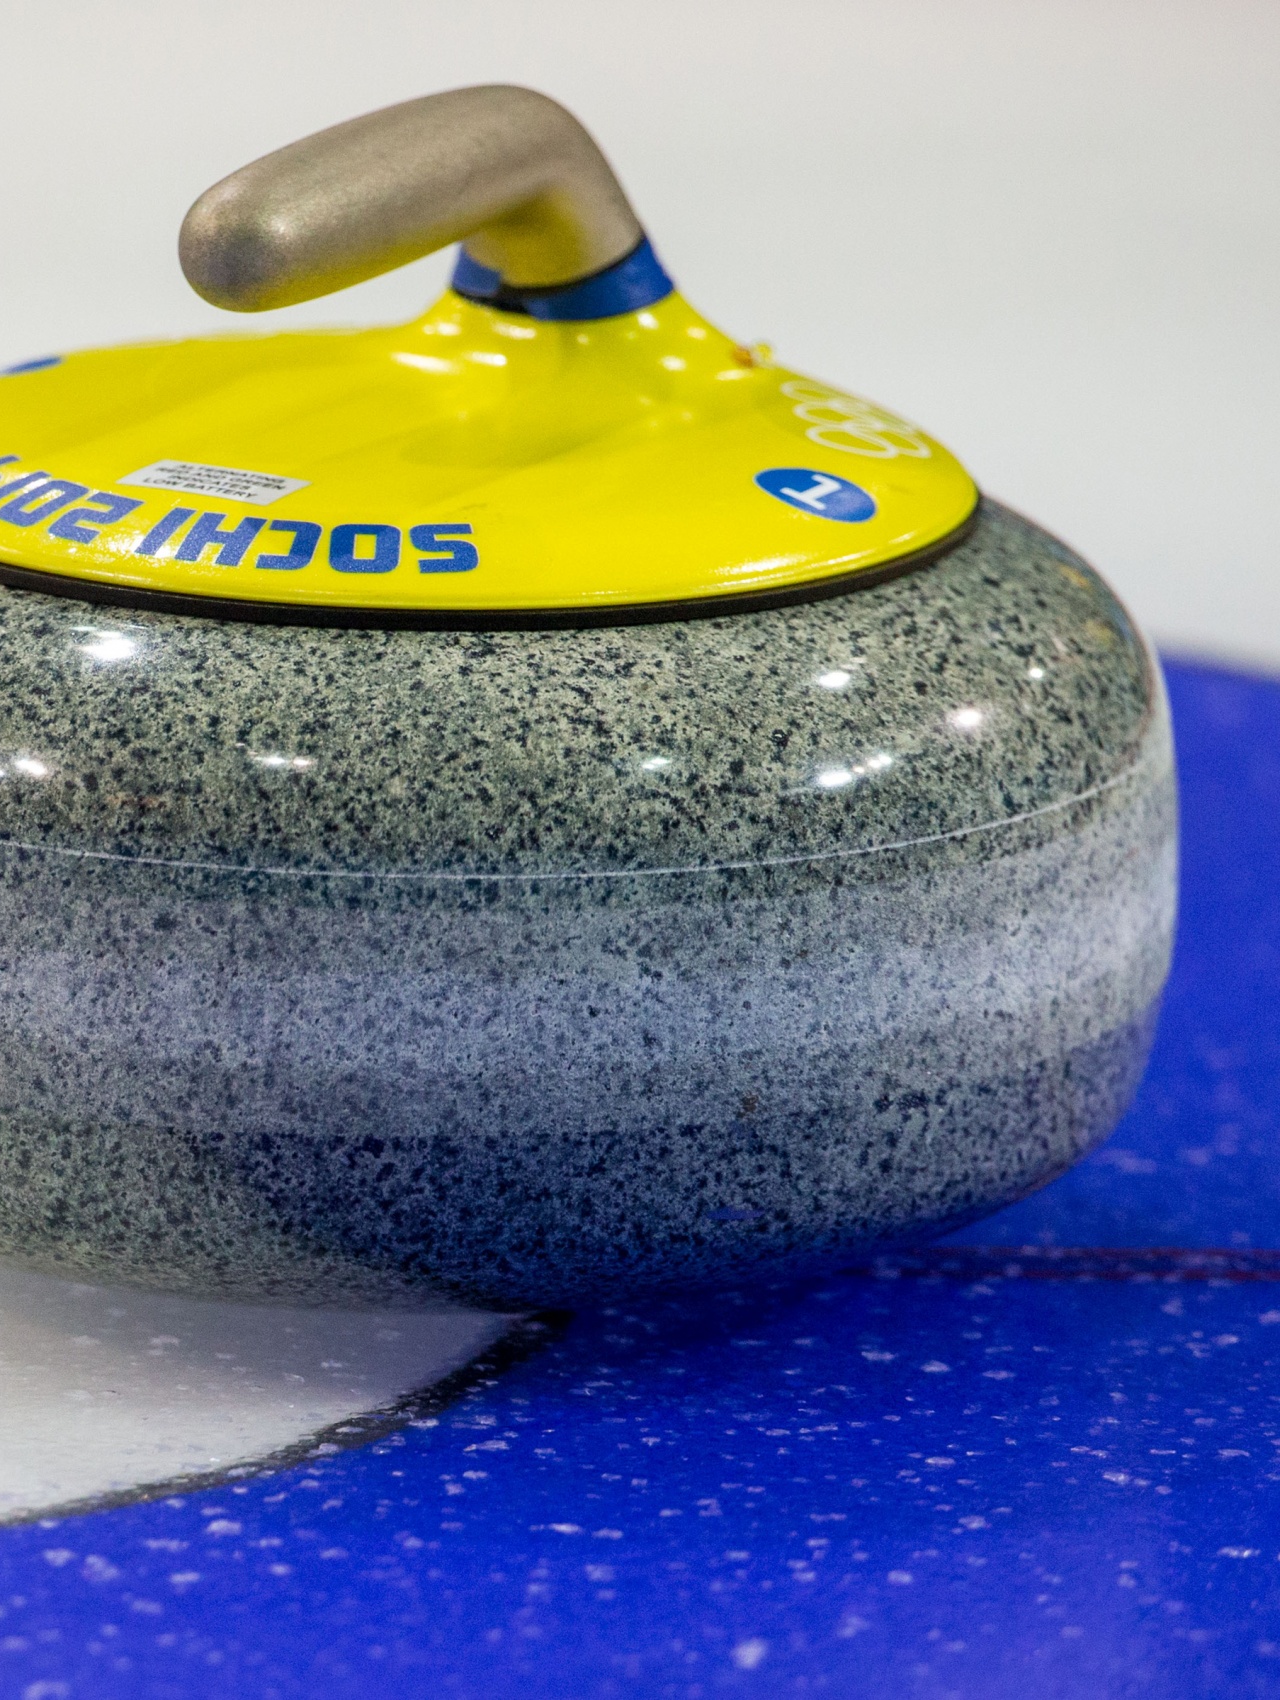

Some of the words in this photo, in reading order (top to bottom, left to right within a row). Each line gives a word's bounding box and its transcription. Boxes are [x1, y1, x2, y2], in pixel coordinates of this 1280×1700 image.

[143, 477, 180, 486] LOW
[182, 482, 258, 498] BATTERY
[167, 475, 251, 490] INDICATES
[191, 472, 226, 480] AND
[229, 477, 286, 490] GREEN
[136, 508, 479, 573] SOCHI
